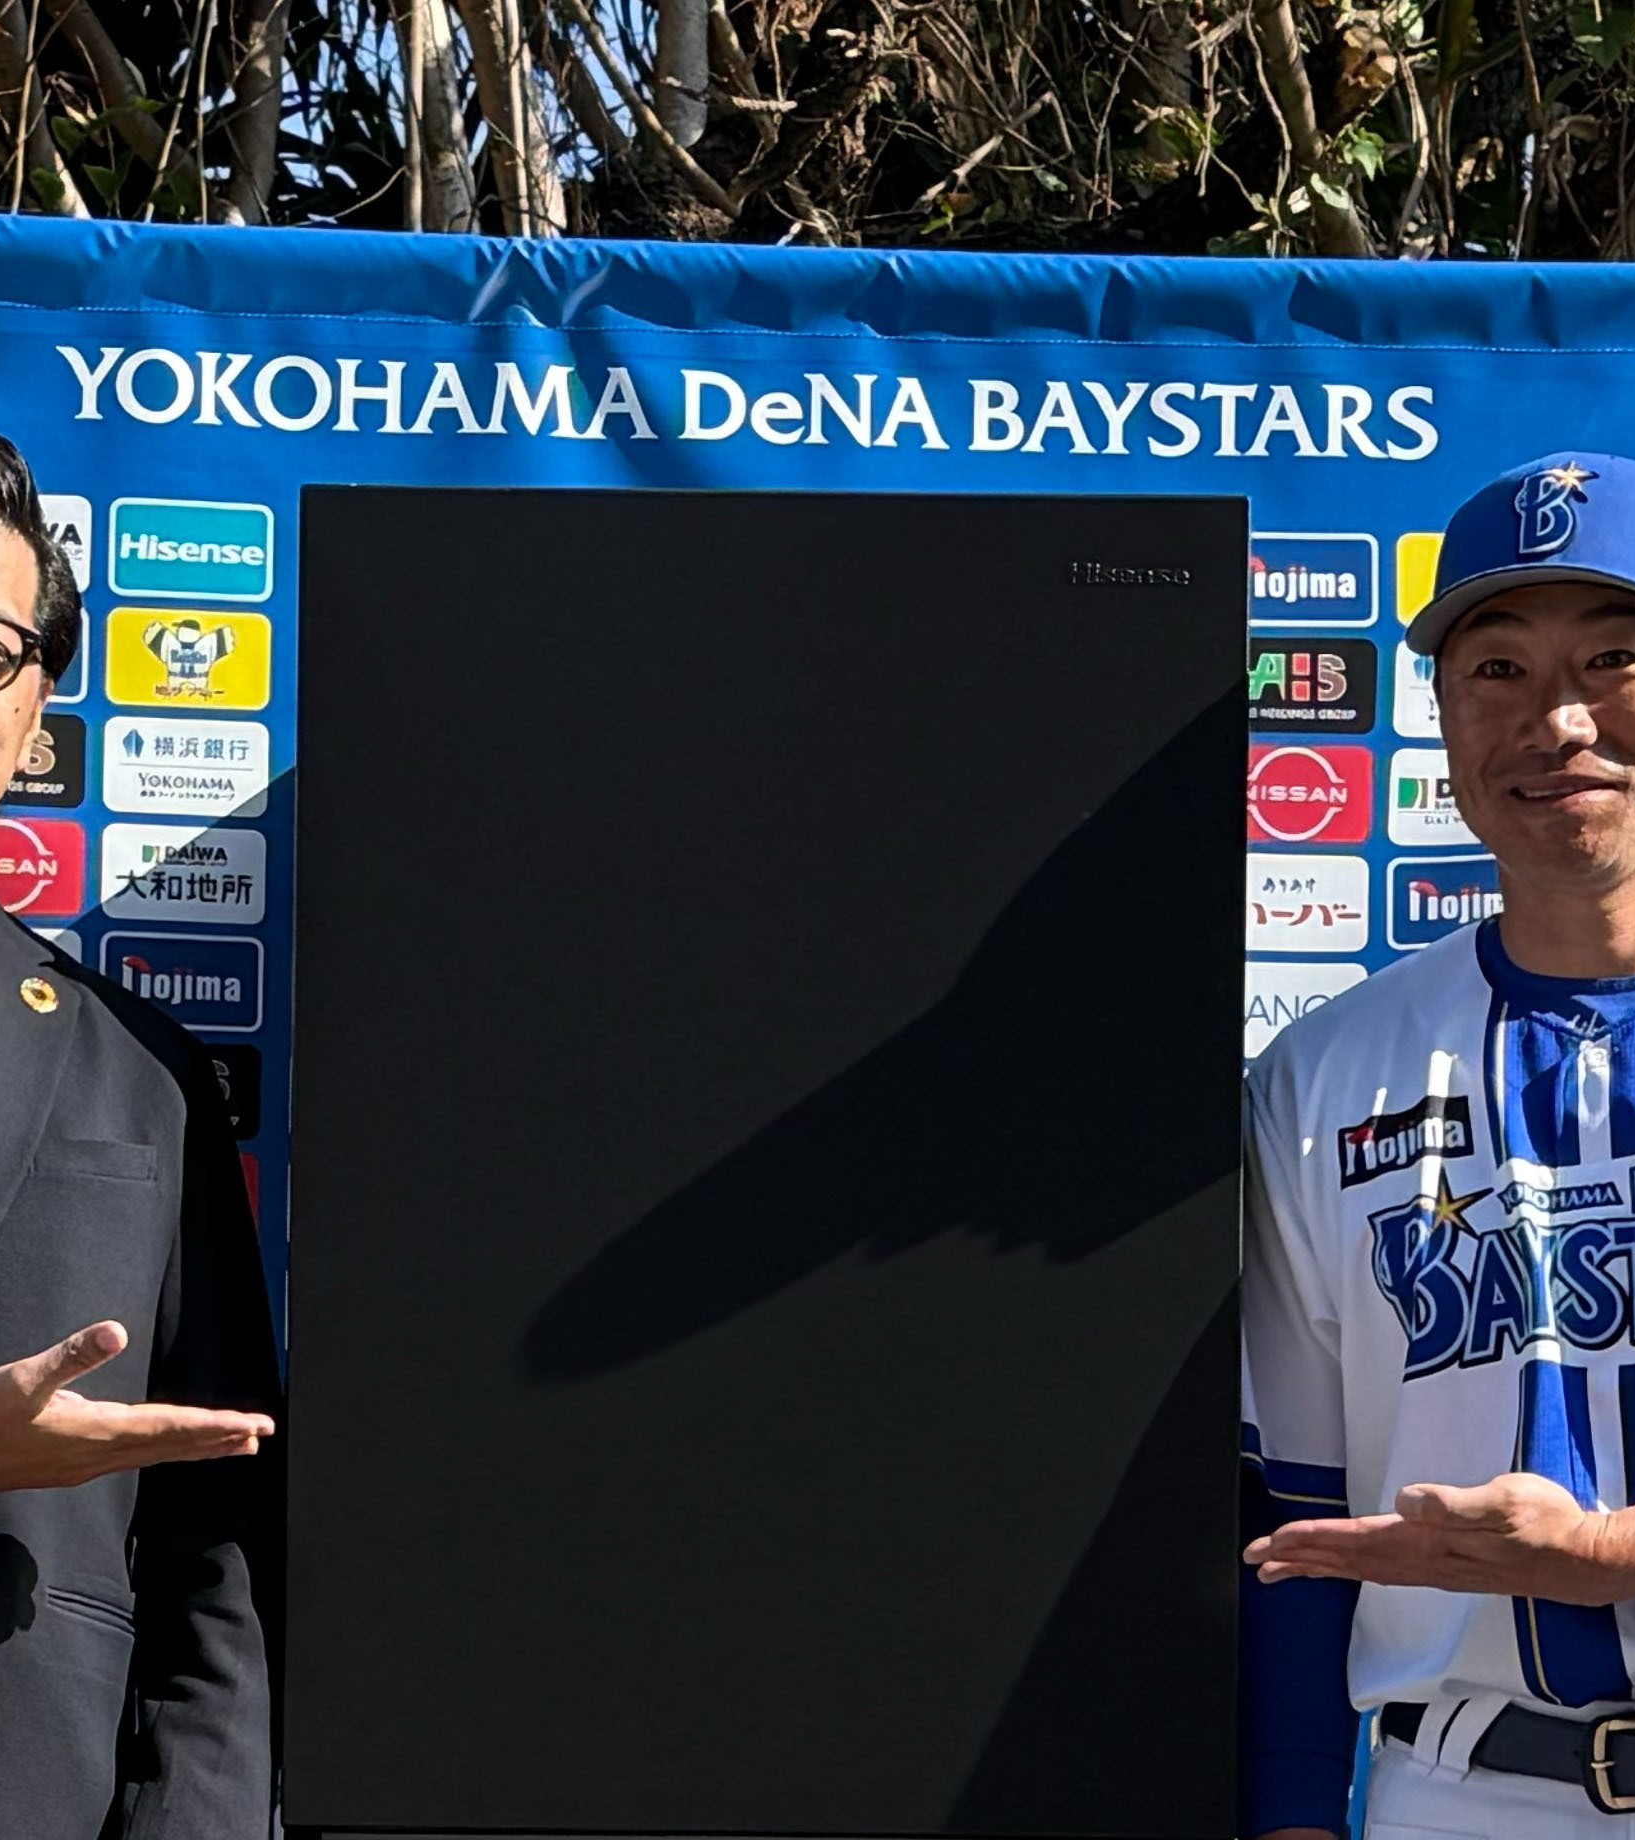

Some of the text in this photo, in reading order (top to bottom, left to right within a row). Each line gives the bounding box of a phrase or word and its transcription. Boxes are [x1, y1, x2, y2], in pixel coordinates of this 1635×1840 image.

[56, 345, 1438, 461] YOKOHAMA DeNA BAYSTARS
[120, 532, 264, 566] Hisense
[1072, 561, 1190, 585] Hisense
[154, 736, 250, 761] 横浜銀行
[138, 773, 235, 791] YOKOHAMA
[116, 870, 253, 905] 大和地所
[1499, 1181, 1623, 1213] YOKOHAMA
